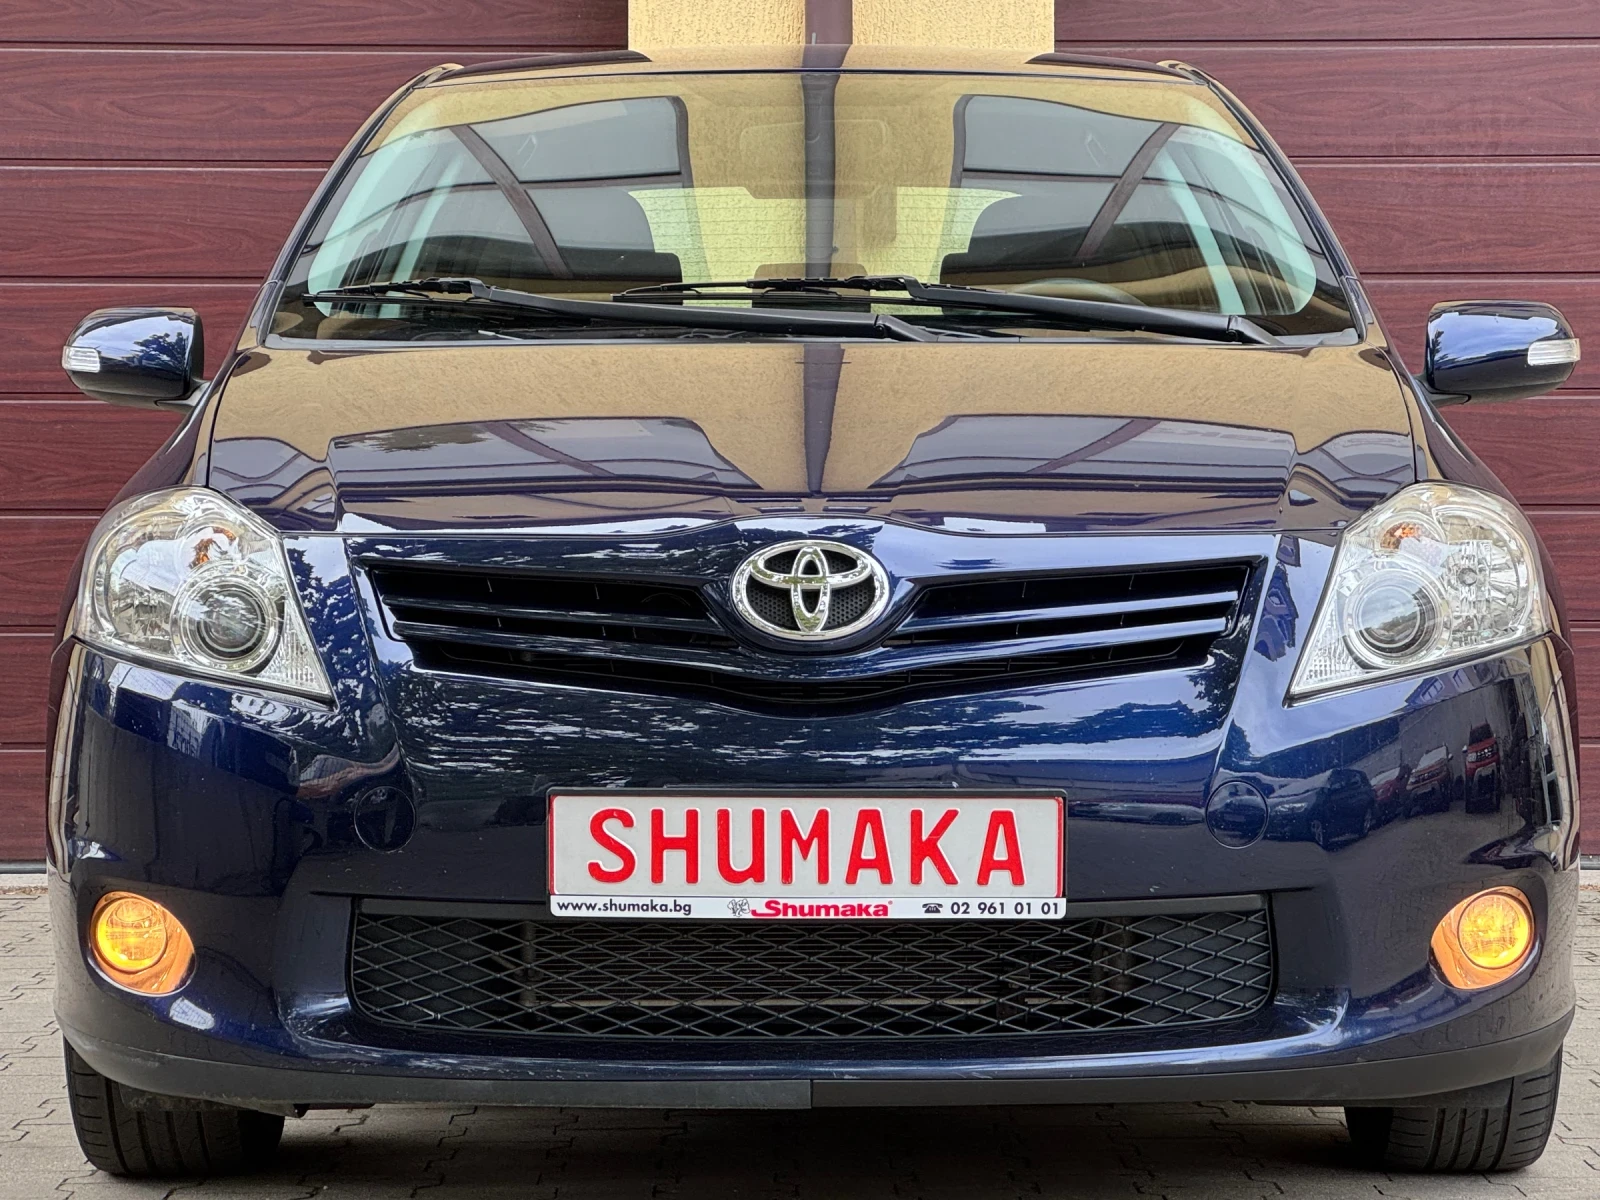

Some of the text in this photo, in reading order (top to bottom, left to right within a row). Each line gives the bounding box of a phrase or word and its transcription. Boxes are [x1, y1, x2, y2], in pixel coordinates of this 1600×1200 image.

[588, 807, 1026, 887] SHUMAKA
[556, 898, 692, 916] www.shumaka.bg
[950, 902, 1058, 916] 02 961 01 01
